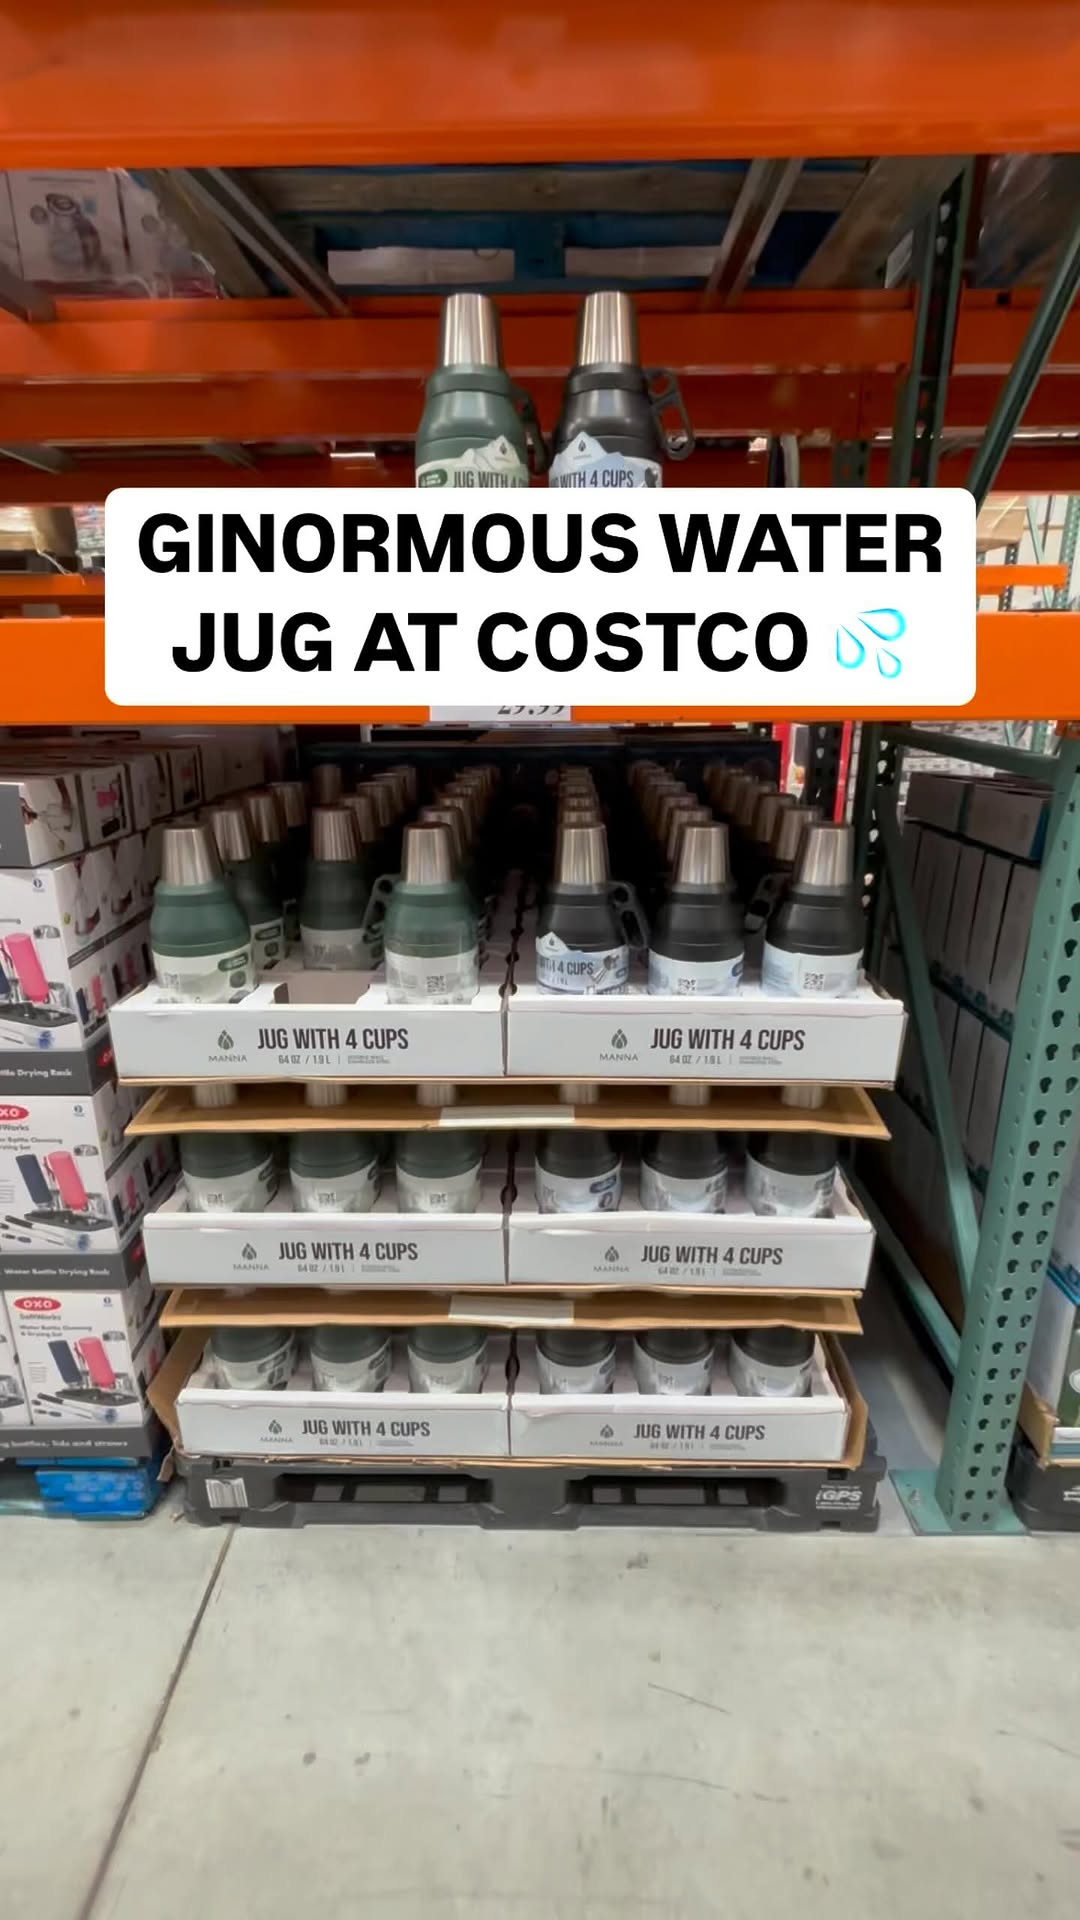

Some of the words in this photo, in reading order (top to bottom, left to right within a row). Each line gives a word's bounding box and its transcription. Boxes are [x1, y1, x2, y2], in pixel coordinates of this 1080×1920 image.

[454, 471, 474, 487] JUG
[478, 471, 508, 487] WITH
[560, 470, 586, 488] WITH
[590, 470, 598, 488] 4
[602, 470, 634, 488] CUPS
[557, 960, 564, 973] 4
[567, 961, 594, 975] CUPS
[257, 1027, 289, 1050] JUG
[292, 1027, 340, 1050] WITH
[345, 1028, 358, 1050] 4
[362, 1027, 409, 1050] CUPS
[650, 1027, 683, 1050] JUG
[688, 1028, 735, 1050] WITH
[739, 1028, 753, 1050] 4
[757, 1029, 806, 1051] CUPS
[278, 1055, 290, 1064] 64
[600, 1053, 638, 1062] MANNA
[278, 1241, 308, 1260] JUG
[310, 1242, 355, 1261] WITH
[359, 1242, 371, 1261] 4
[375, 1242, 419, 1261] CUPS
[640, 1244, 671, 1264] JUG
[675, 1245, 719, 1264] WITH
[722, 1246, 735, 1265] 4
[739, 1246, 784, 1266] CUPS
[23, 1300, 53, 1308] OXO
[302, 1419, 329, 1435] JUG
[331, 1419, 372, 1436] WITH
[375, 1421, 386, 1437] 4
[390, 1421, 431, 1437] CUPS
[633, 1423, 661, 1439] JUG
[665, 1423, 706, 1440] WITH
[709, 1425, 721, 1440] 4
[724, 1424, 766, 1441] CUPS
